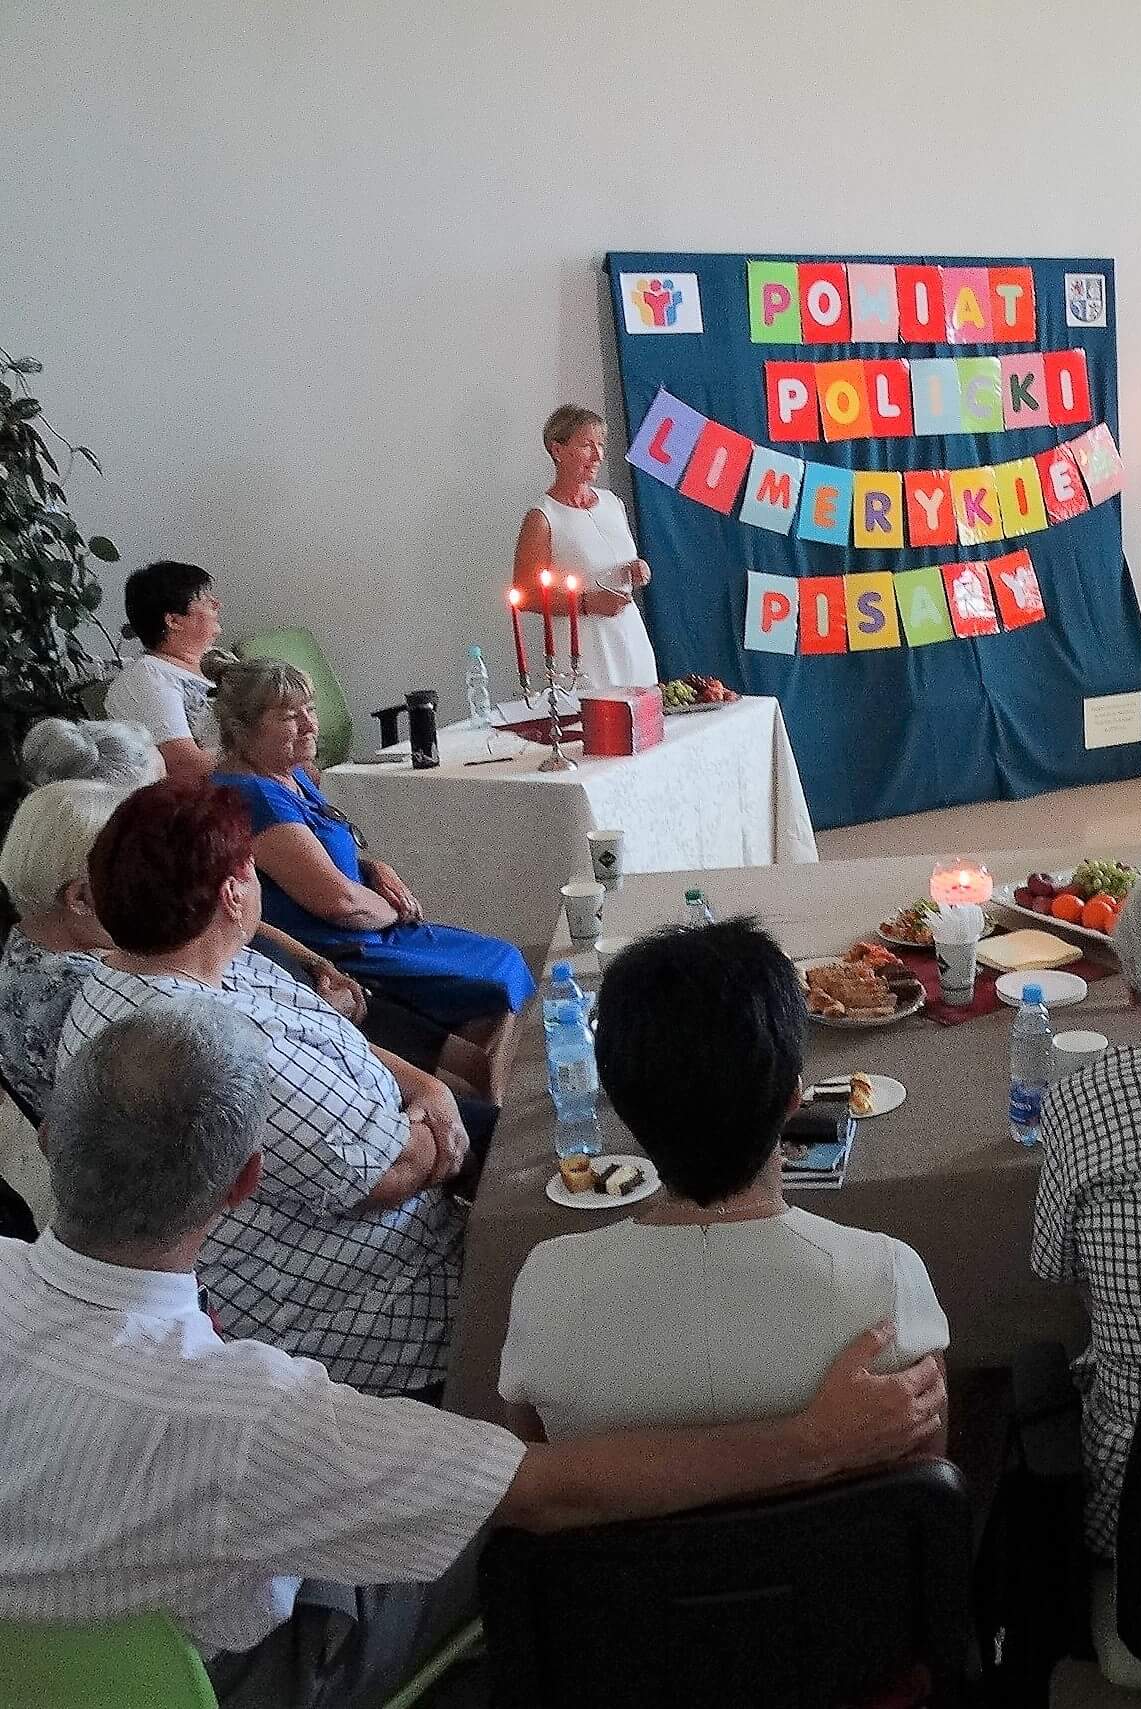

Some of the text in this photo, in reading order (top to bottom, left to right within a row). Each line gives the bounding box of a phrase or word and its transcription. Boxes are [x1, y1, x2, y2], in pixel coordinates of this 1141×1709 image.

[762, 279, 1023, 330] POWIAT
[777, 368, 1076, 425] POLICKI
[648, 417, 1114, 533] LIMERYKIE
[761, 566, 1036, 638] PISAY
